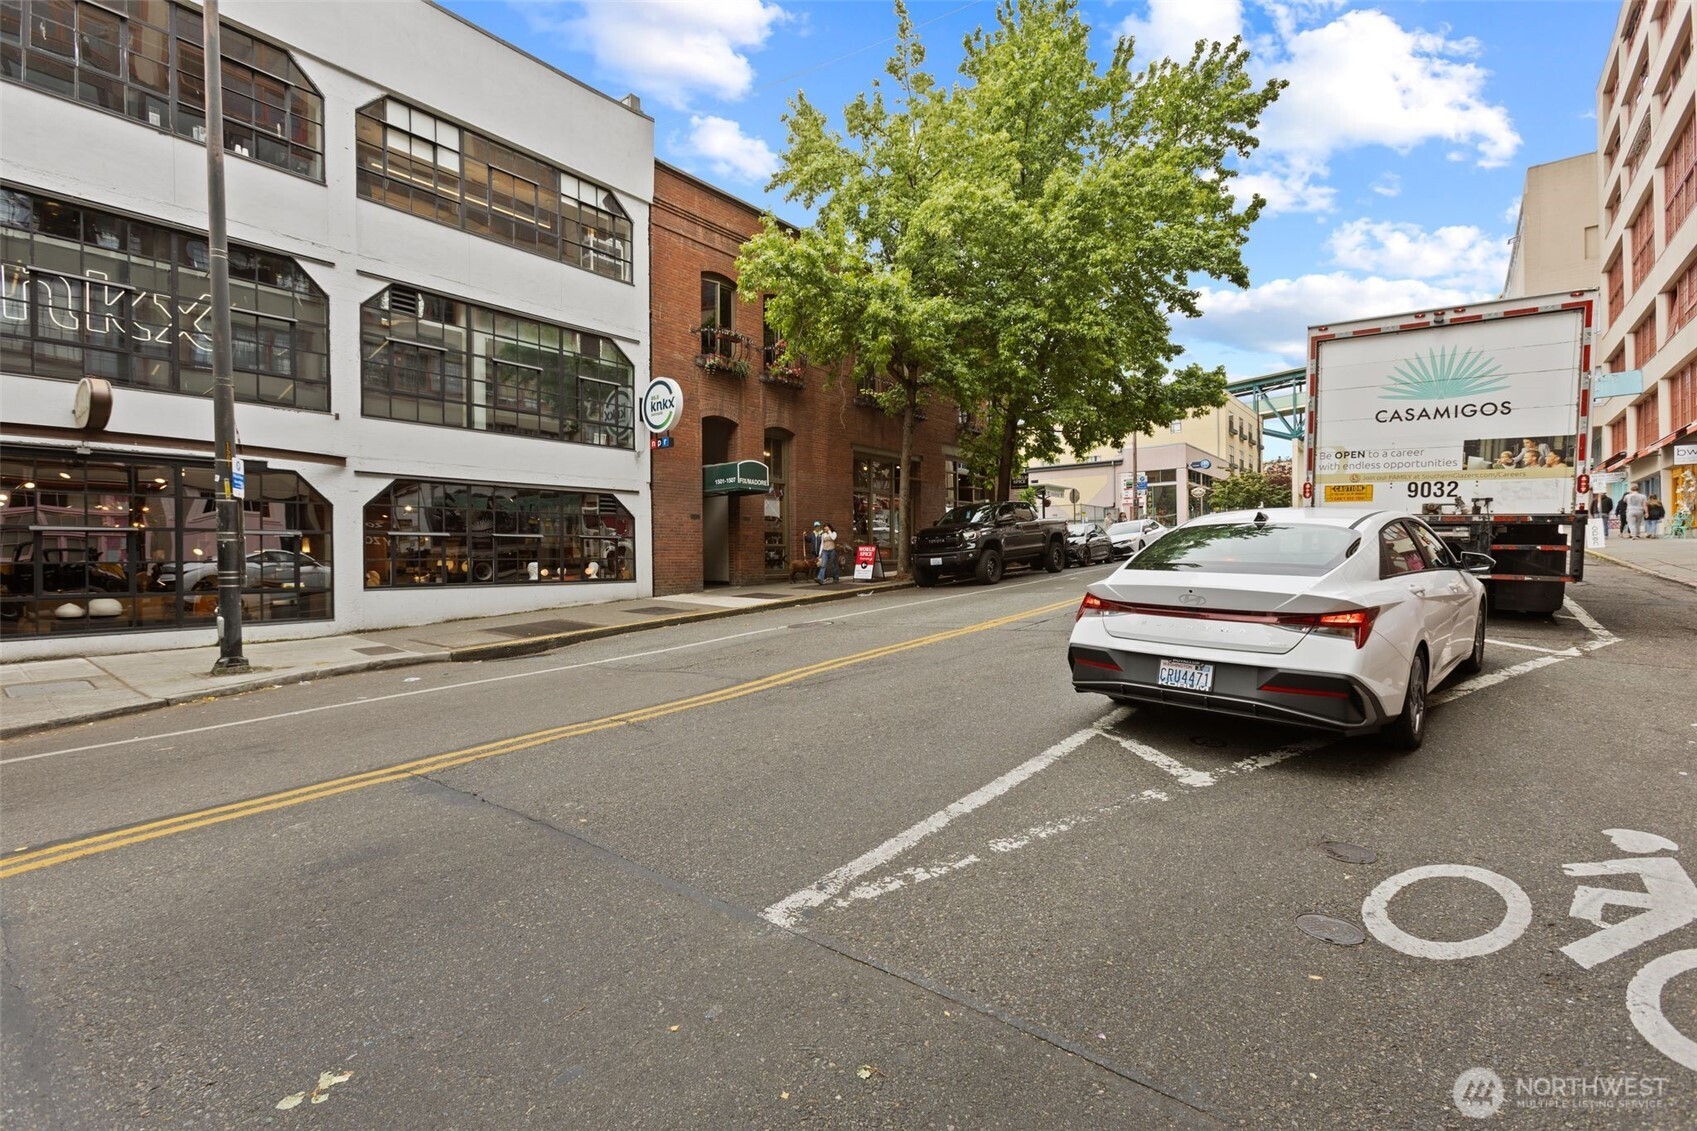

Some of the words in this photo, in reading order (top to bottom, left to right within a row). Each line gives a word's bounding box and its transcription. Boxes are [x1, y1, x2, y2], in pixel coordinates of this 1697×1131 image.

[650, 396, 675, 413] knkx
[1375, 401, 1512, 423] CASAMIGOS
[651, 437, 668, 448] npr
[1320, 452, 1333, 460] Be
[1335, 450, 1366, 459] OPEN
[1368, 450, 1380, 458] to
[1382, 450, 1388, 458] a
[1390, 448, 1425, 457] career
[1319, 462, 1340, 471] with
[1342, 460, 1381, 470] endless
[1383, 458, 1458, 471] opportunities
[1407, 481, 1459, 498] 9032
[1162, 661, 1194, 669] WASHINGTON
[1160, 667, 1209, 687] CRU4471
